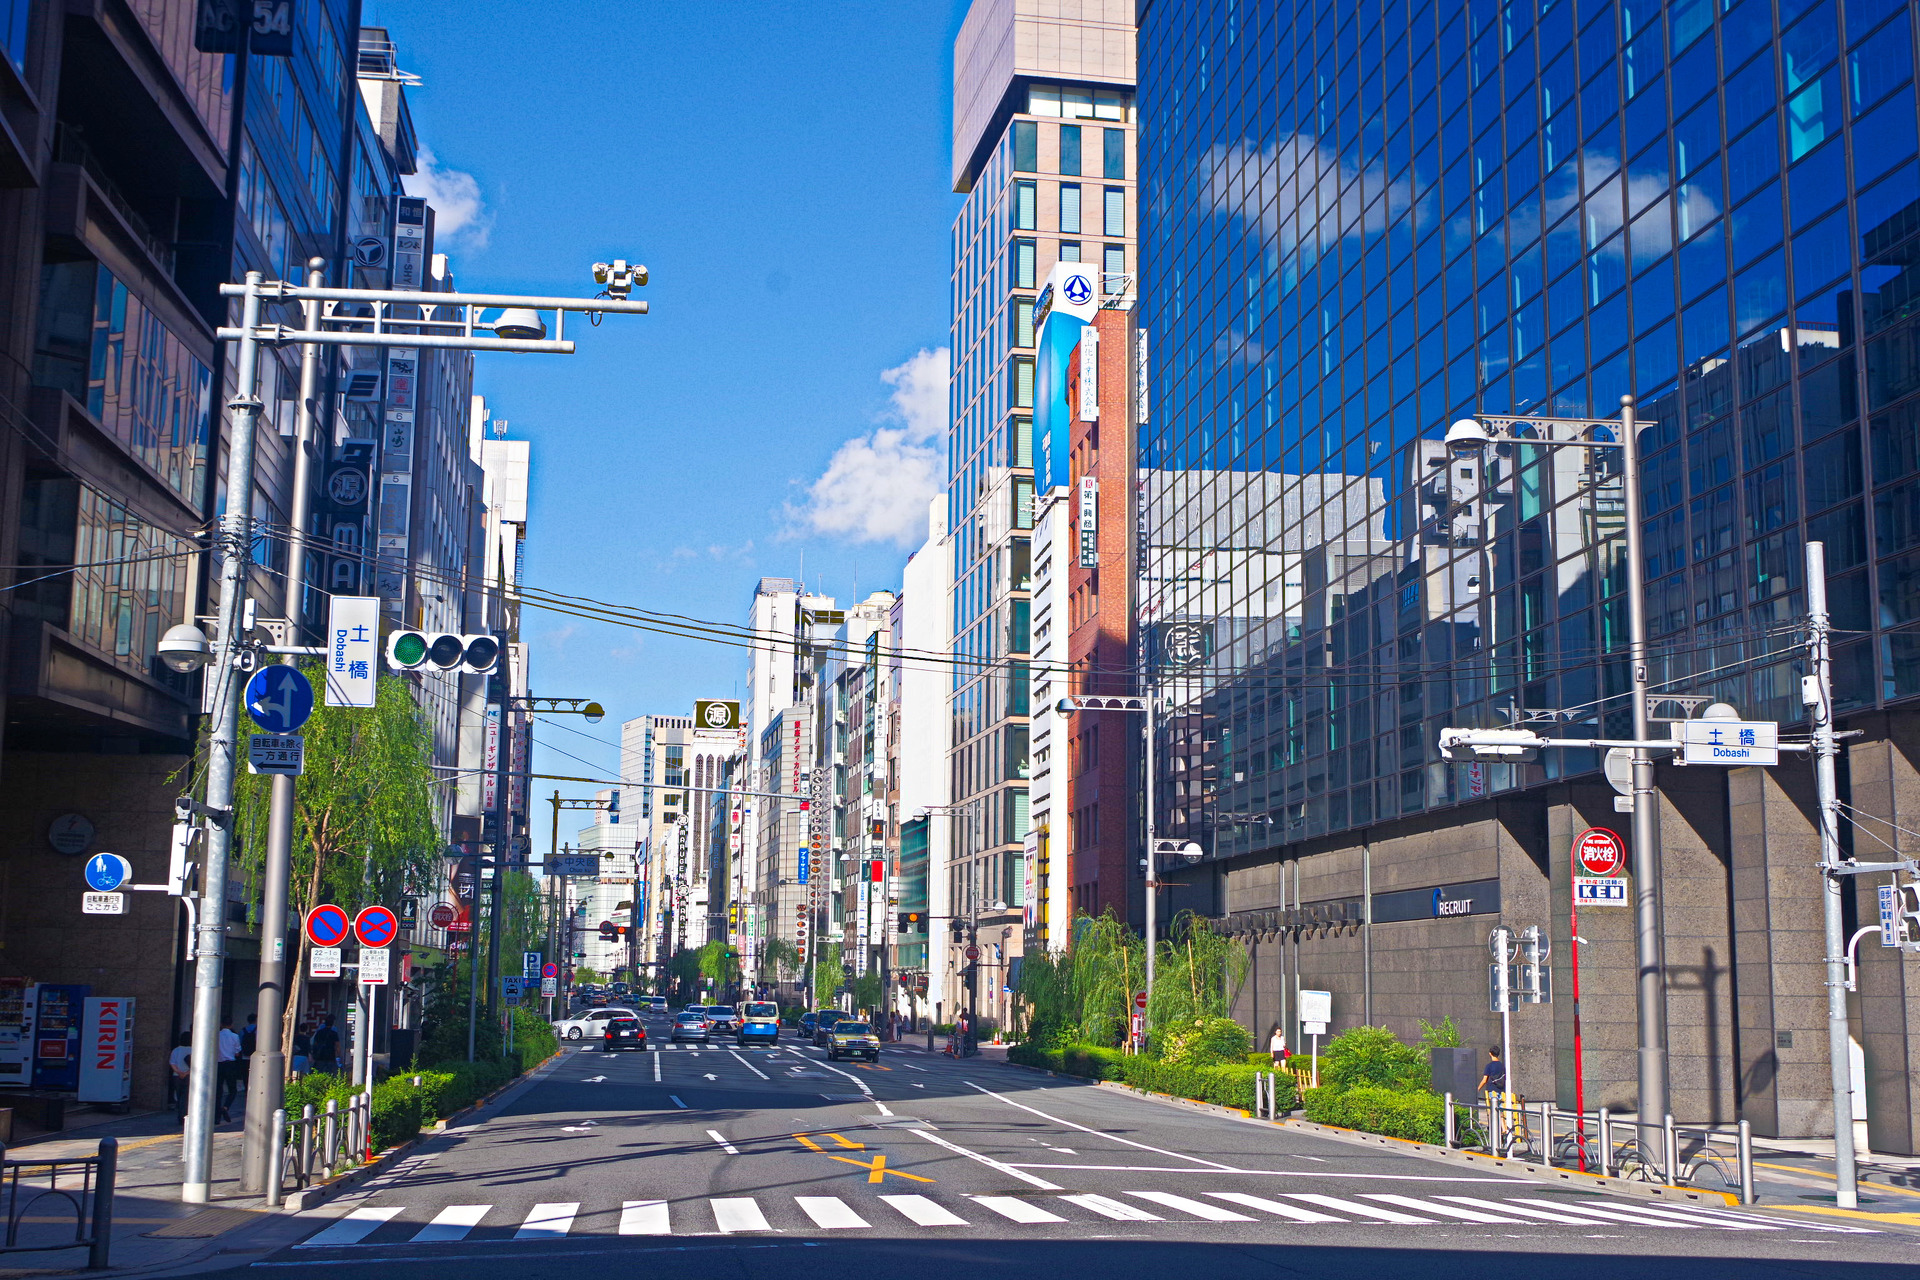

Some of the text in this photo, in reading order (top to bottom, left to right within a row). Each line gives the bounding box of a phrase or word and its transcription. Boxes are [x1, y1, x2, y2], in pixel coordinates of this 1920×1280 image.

[253, 1, 291, 36] 54
[400, 350, 406, 358] 7
[396, 412, 403, 420] 6
[392, 475, 399, 483] 5
[388, 538, 396, 547] 4
[335, 629, 348, 673] Dobashi
[348, 624, 370, 680] 土橋
[708, 706, 727, 724] 源
[1707, 728, 1755, 746] 土橋
[252, 738, 301, 750] 自転車を除く
[253, 750, 300, 762] 一方通行
[1713, 747, 1750, 758] Dobashi
[1583, 846, 1615, 862] 消火栓
[564, 857, 596, 867] 中央区
[1582, 886, 1620, 898] KEN
[86, 894, 121, 904] 自転車通行可
[86, 903, 119, 912] ここから
[1439, 899, 1472, 916] RECRUIT
[527, 954, 538, 967] P
[96, 1001, 119, 1070] KIRIN
